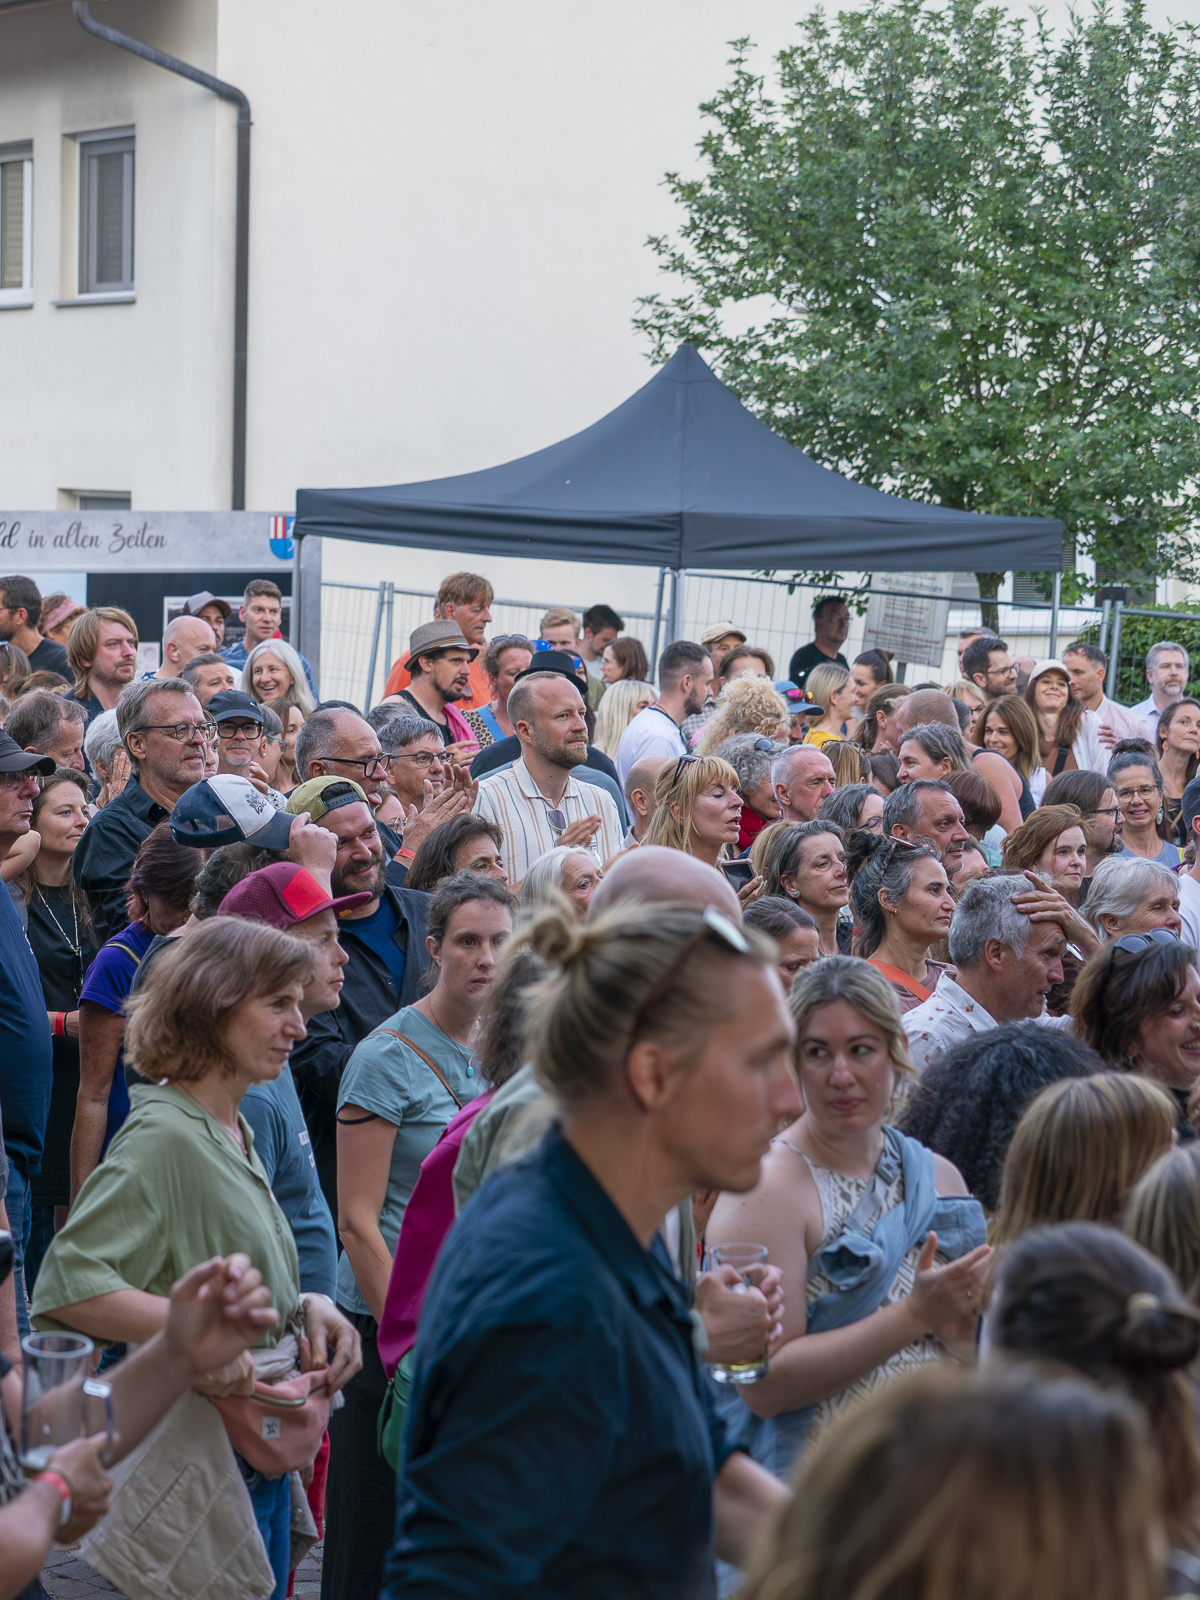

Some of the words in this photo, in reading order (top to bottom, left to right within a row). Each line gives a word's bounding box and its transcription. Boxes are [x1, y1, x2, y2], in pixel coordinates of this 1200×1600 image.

[28, 530, 45, 548] in
[53, 520, 102, 548] alten
[108, 521, 167, 553] Zeiten
